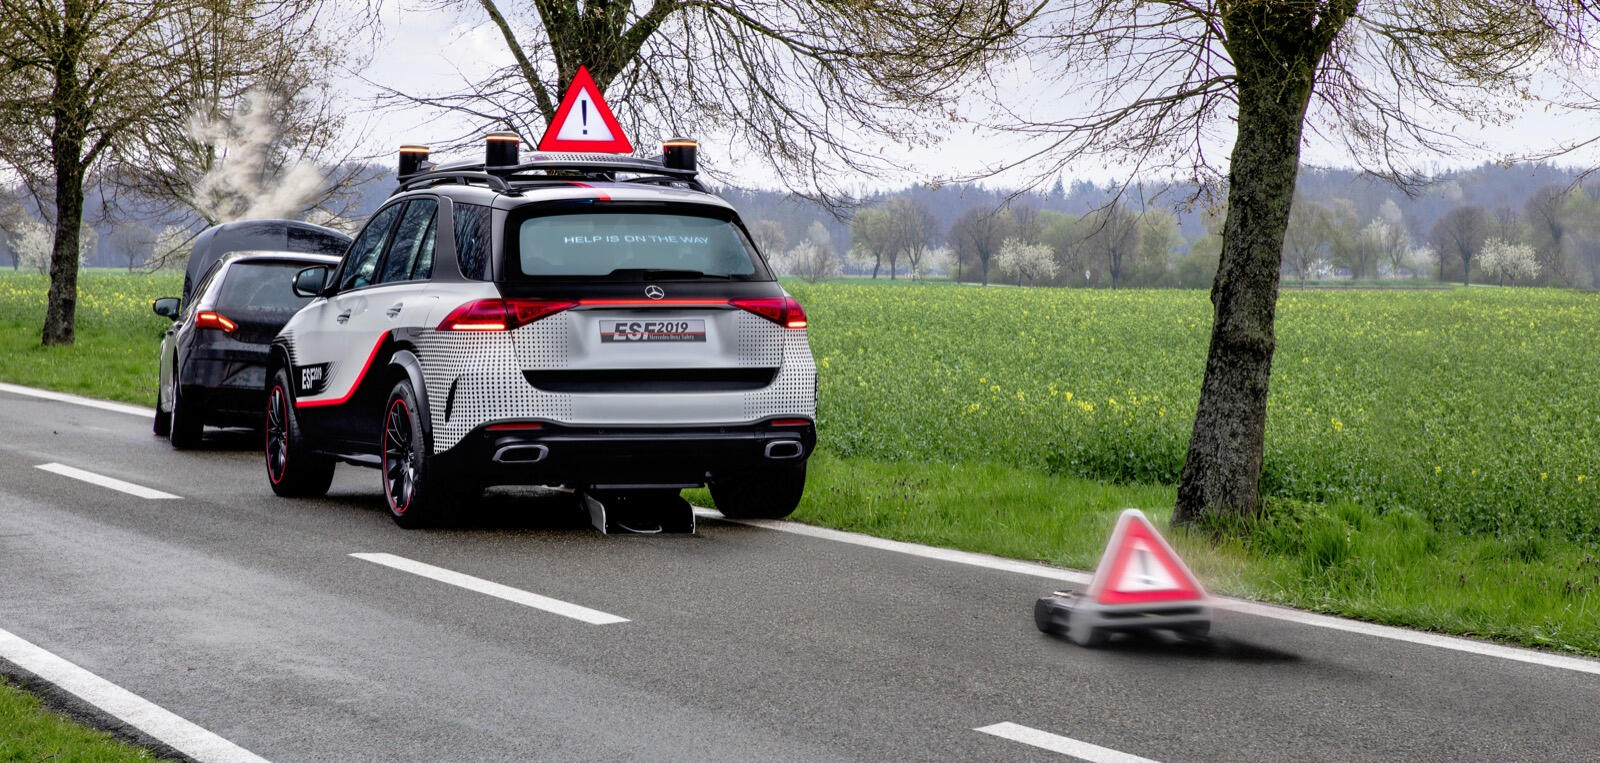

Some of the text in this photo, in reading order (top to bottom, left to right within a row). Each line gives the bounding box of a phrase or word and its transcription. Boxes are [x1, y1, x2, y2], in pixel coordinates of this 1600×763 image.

[564, 235, 709, 245] HELP IS ON THE WAY
